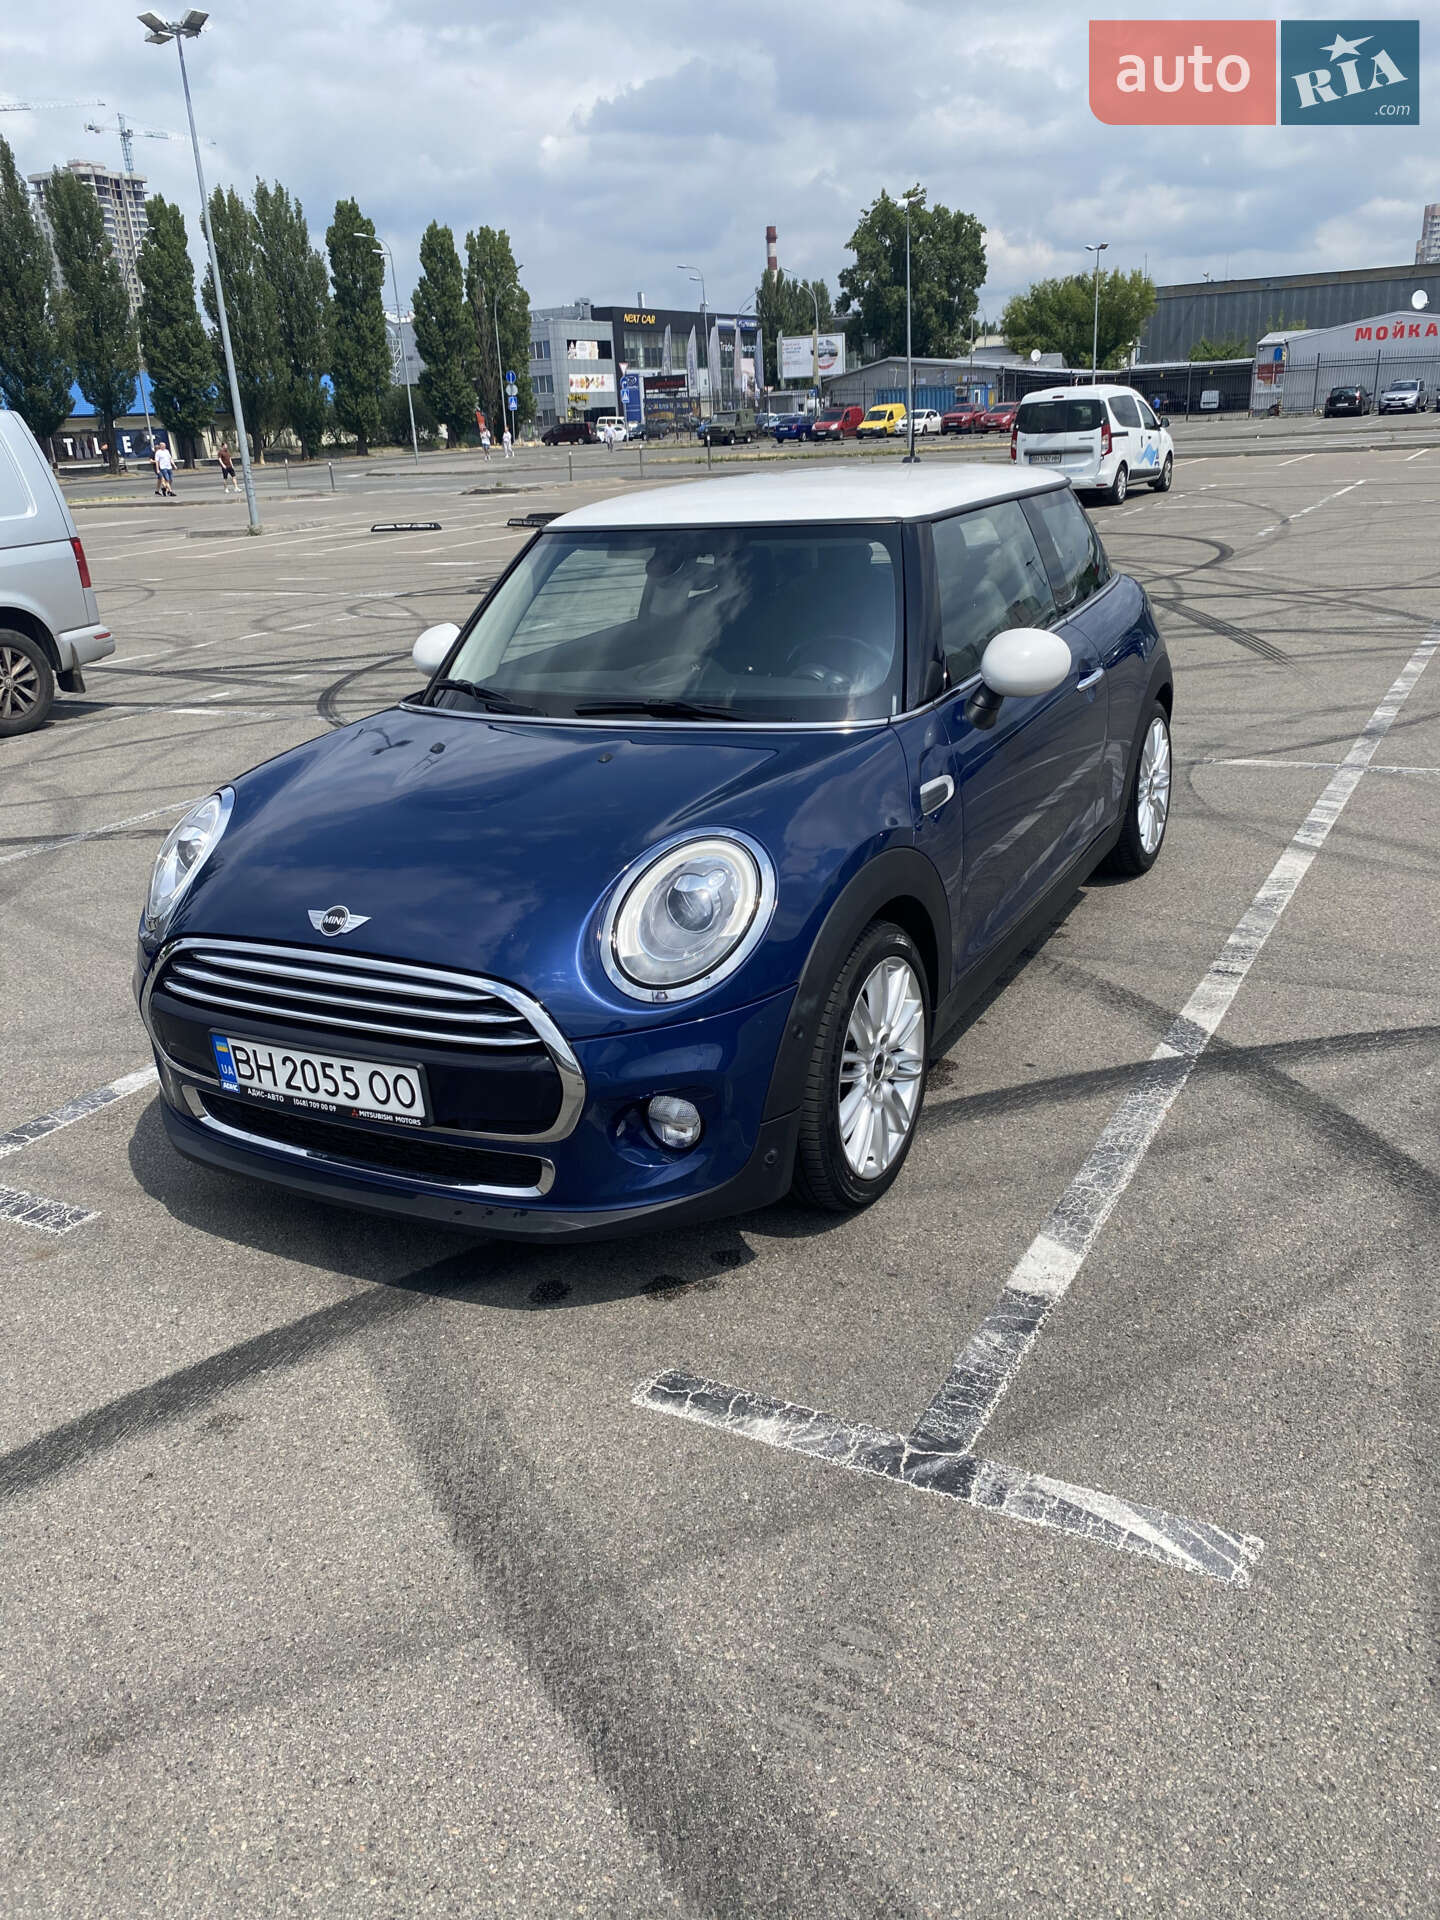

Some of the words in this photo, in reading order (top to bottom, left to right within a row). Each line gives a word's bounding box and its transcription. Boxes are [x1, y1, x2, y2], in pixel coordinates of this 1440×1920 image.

[623, 313, 640, 324] NEXT
[641, 314, 656, 325] CAR
[1355, 320, 1439, 342] МОЙКА
[324, 915, 346, 925] MINI
[221, 1063, 235, 1077] UA
[231, 1045, 278, 1087] BH
[282, 1056, 360, 1100] 2055
[358, 1110, 394, 1122] MITSUBISHI
[395, 1116, 421, 1126] MOTORS
